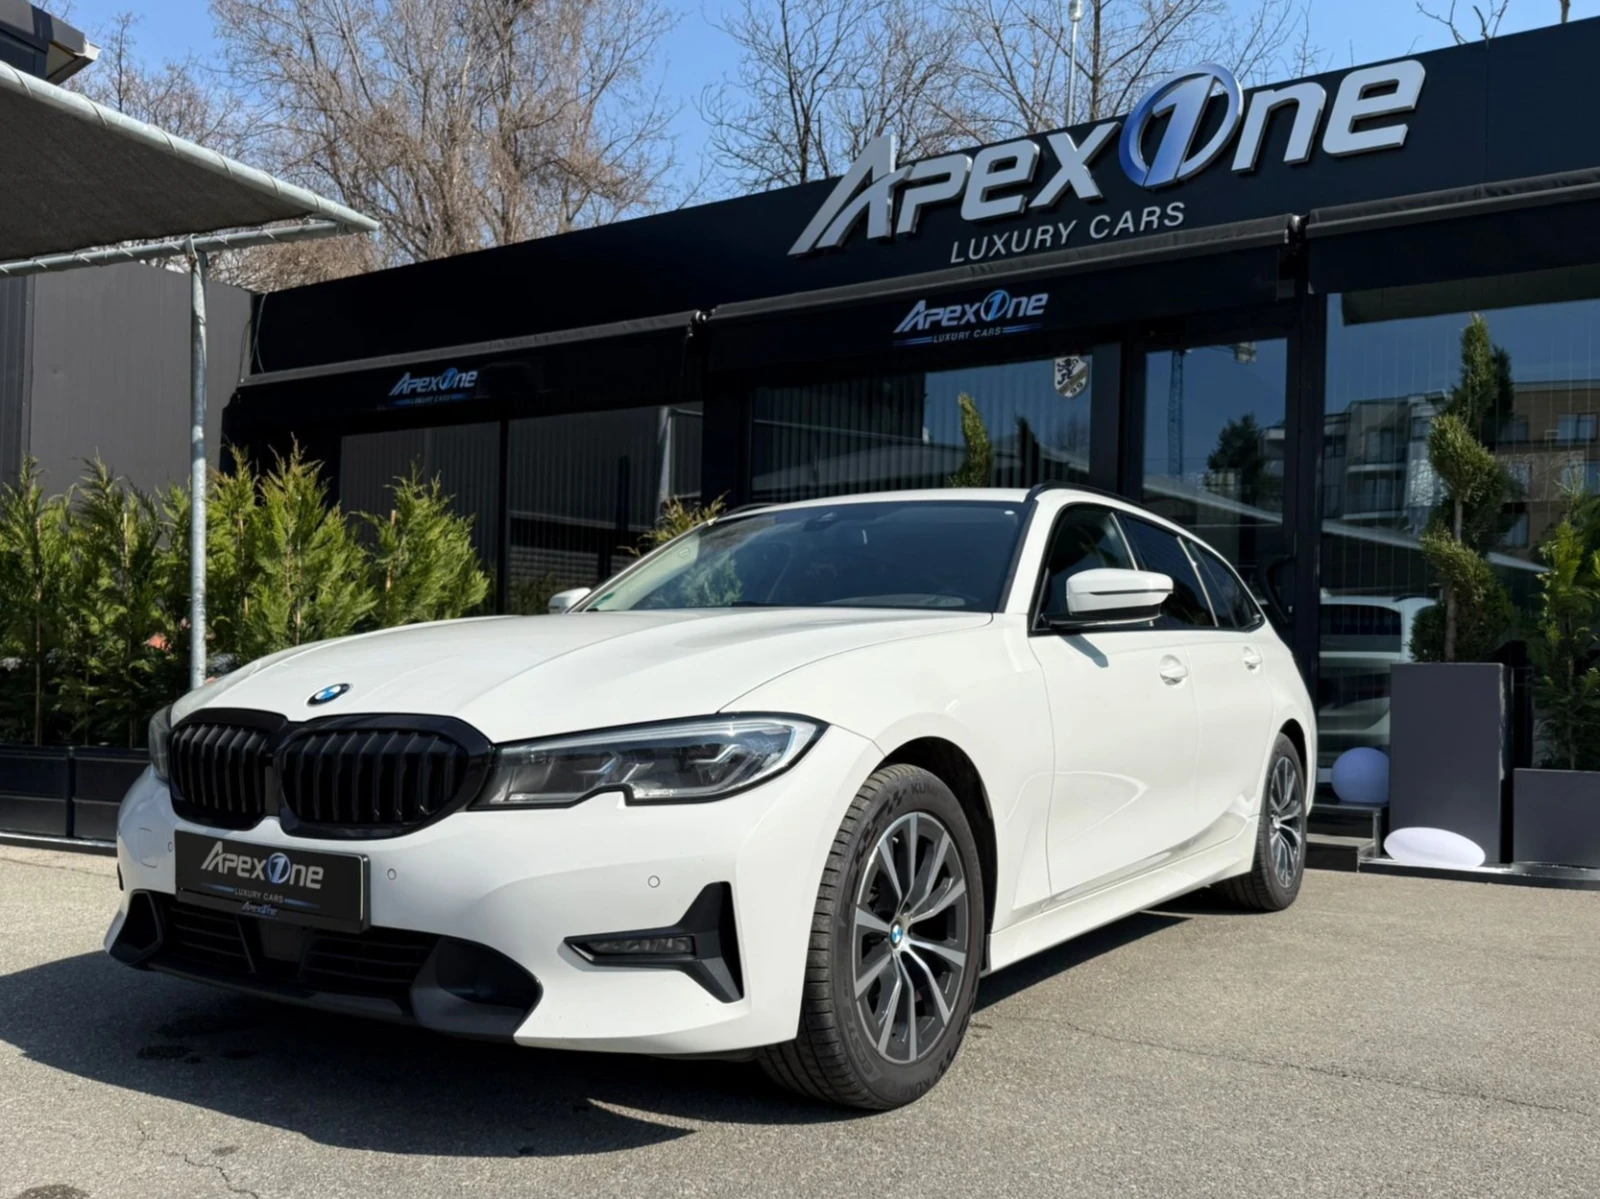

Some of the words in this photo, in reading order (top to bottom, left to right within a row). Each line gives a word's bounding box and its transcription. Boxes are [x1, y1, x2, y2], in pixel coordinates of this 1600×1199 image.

[949, 219, 1077, 263] LUXURY
[1089, 202, 1185, 239] CARS
[933, 331, 971, 344] LUXURY
[973, 327, 1001, 338] CARS
[234, 887, 262, 900] LUXURY
[263, 892, 284, 904] CARS
